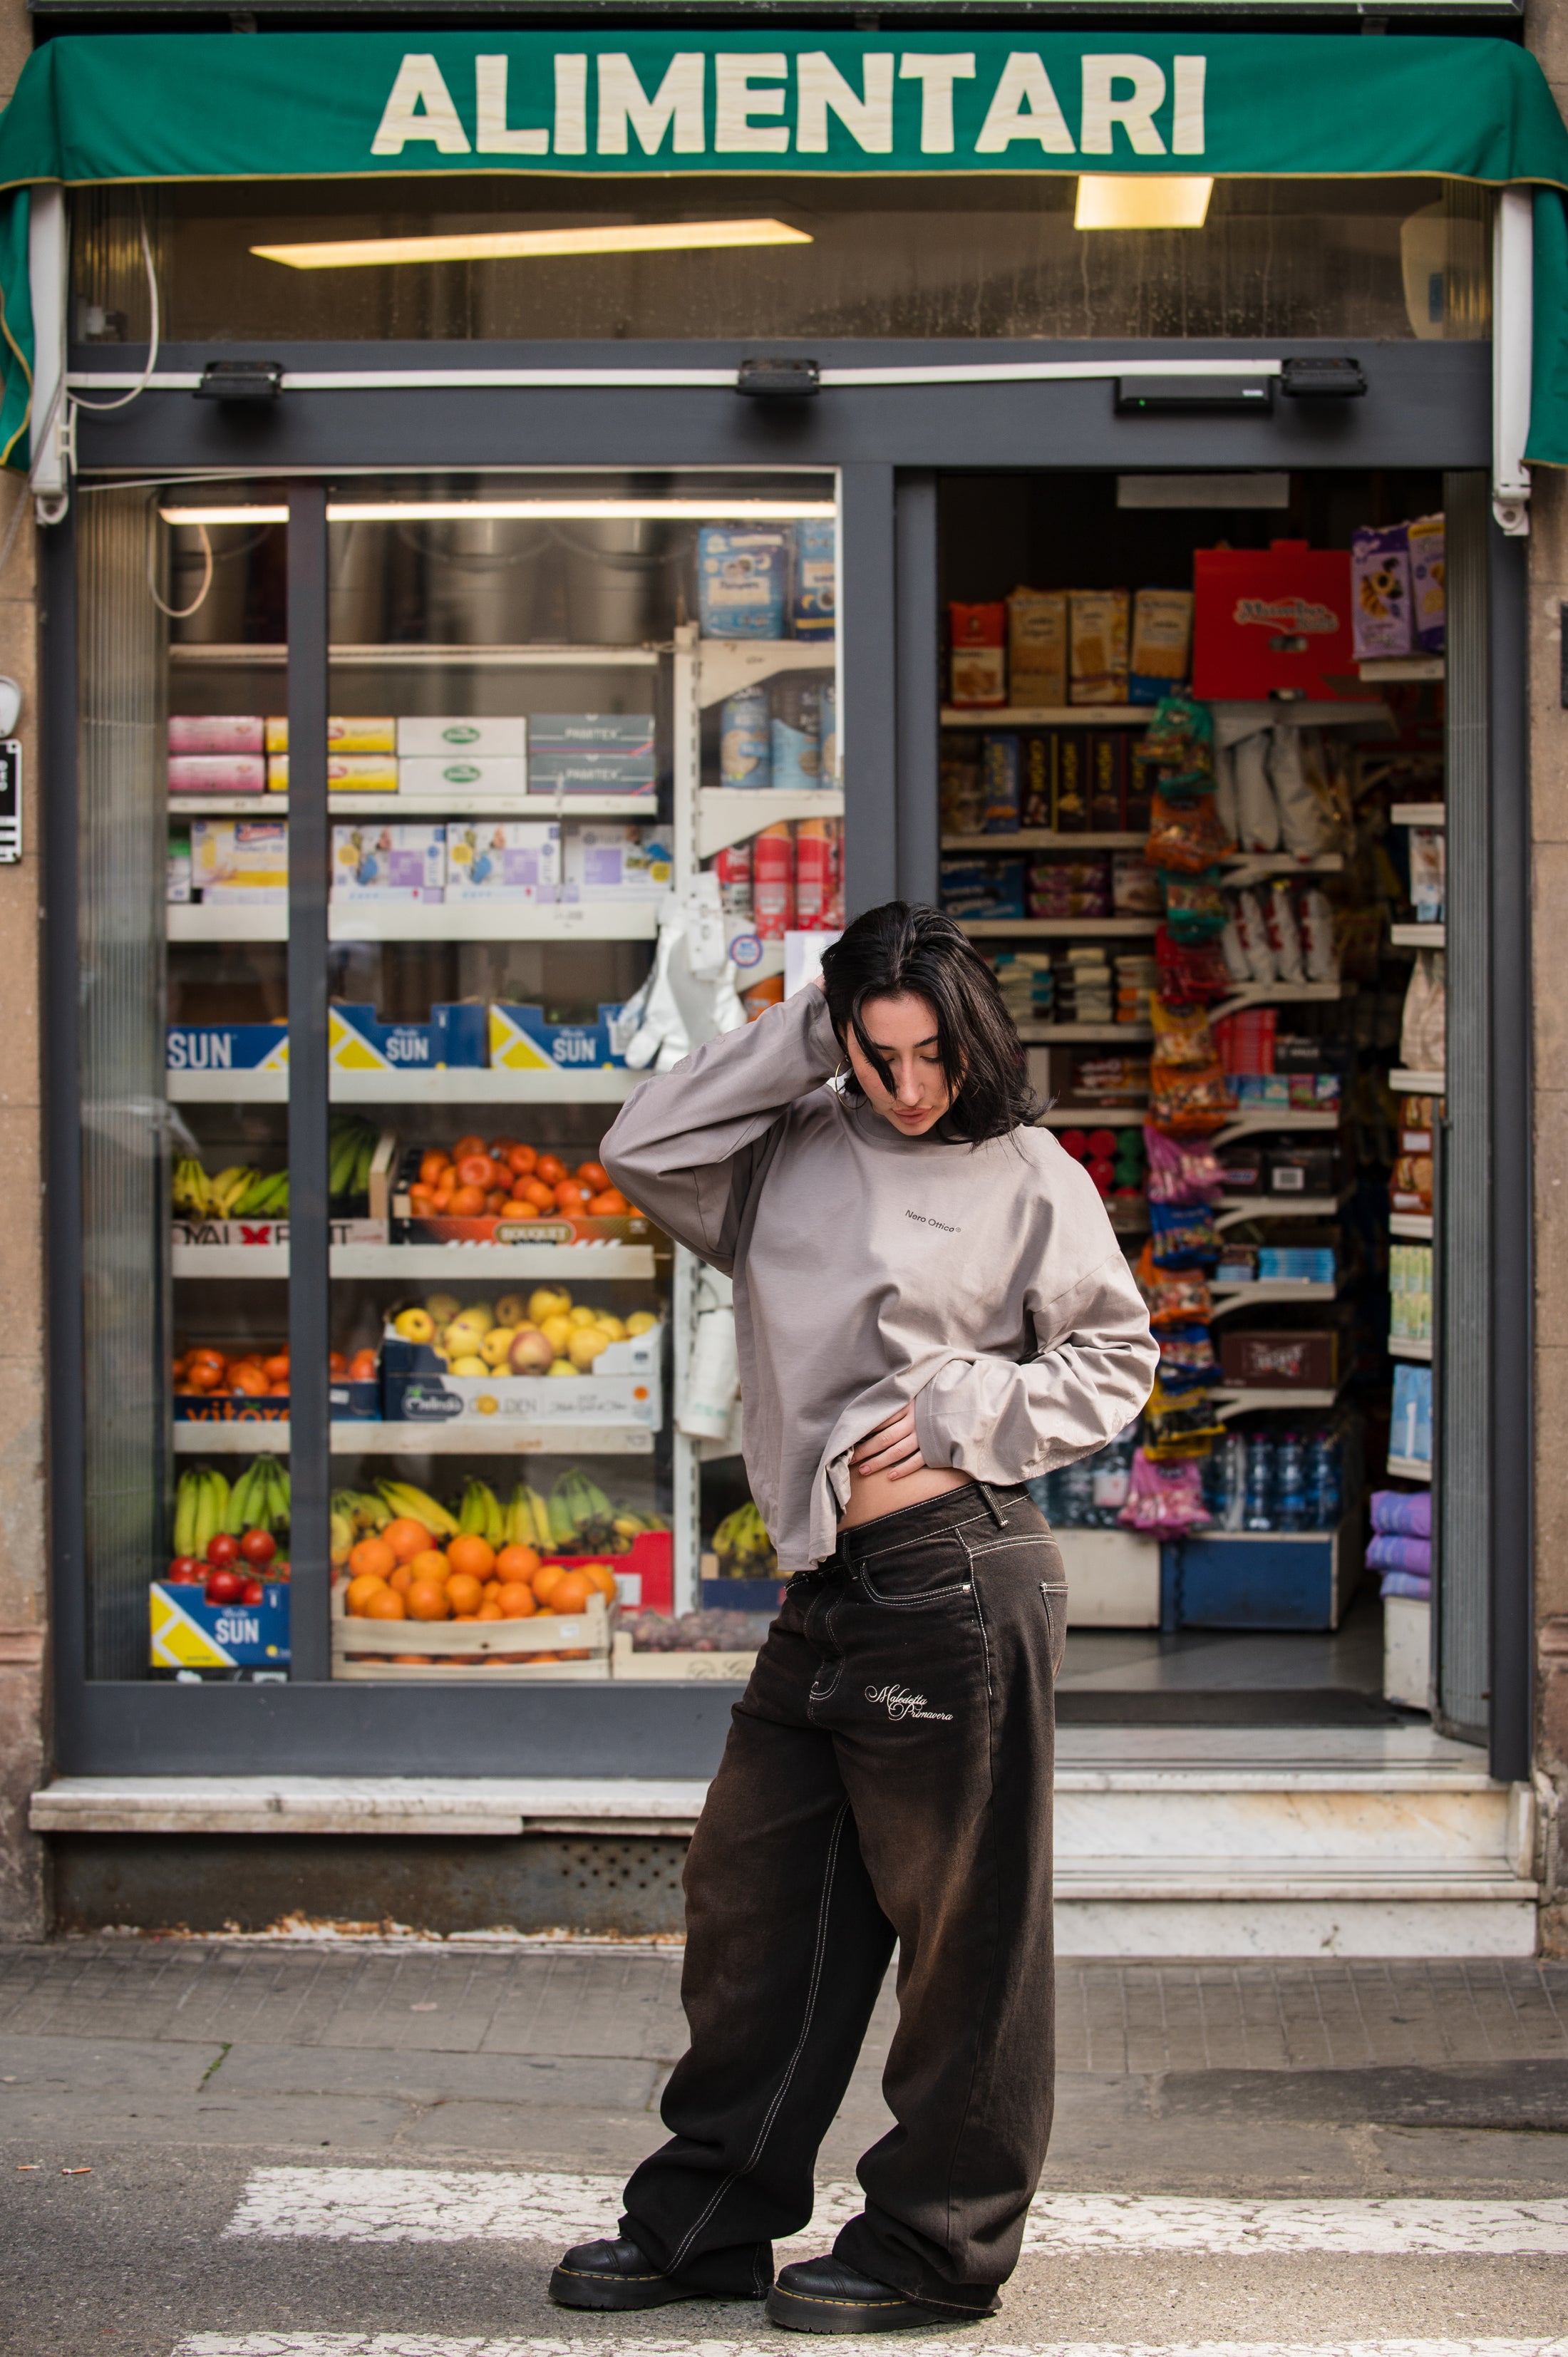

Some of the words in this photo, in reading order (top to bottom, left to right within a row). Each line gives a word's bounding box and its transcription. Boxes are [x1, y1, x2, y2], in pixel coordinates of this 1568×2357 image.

[370, 51, 1207, 156] ALIMENTARI
[167, 1033, 232, 1068] SUN
[386, 1038, 428, 1062] SUN
[552, 1038, 597, 1062] SUN
[904, 1210, 927, 1222] Nero
[215, 1618, 259, 1644] SUN
[865, 1683, 928, 1711] Maledetta
[888, 1703, 954, 1721] Primavera
